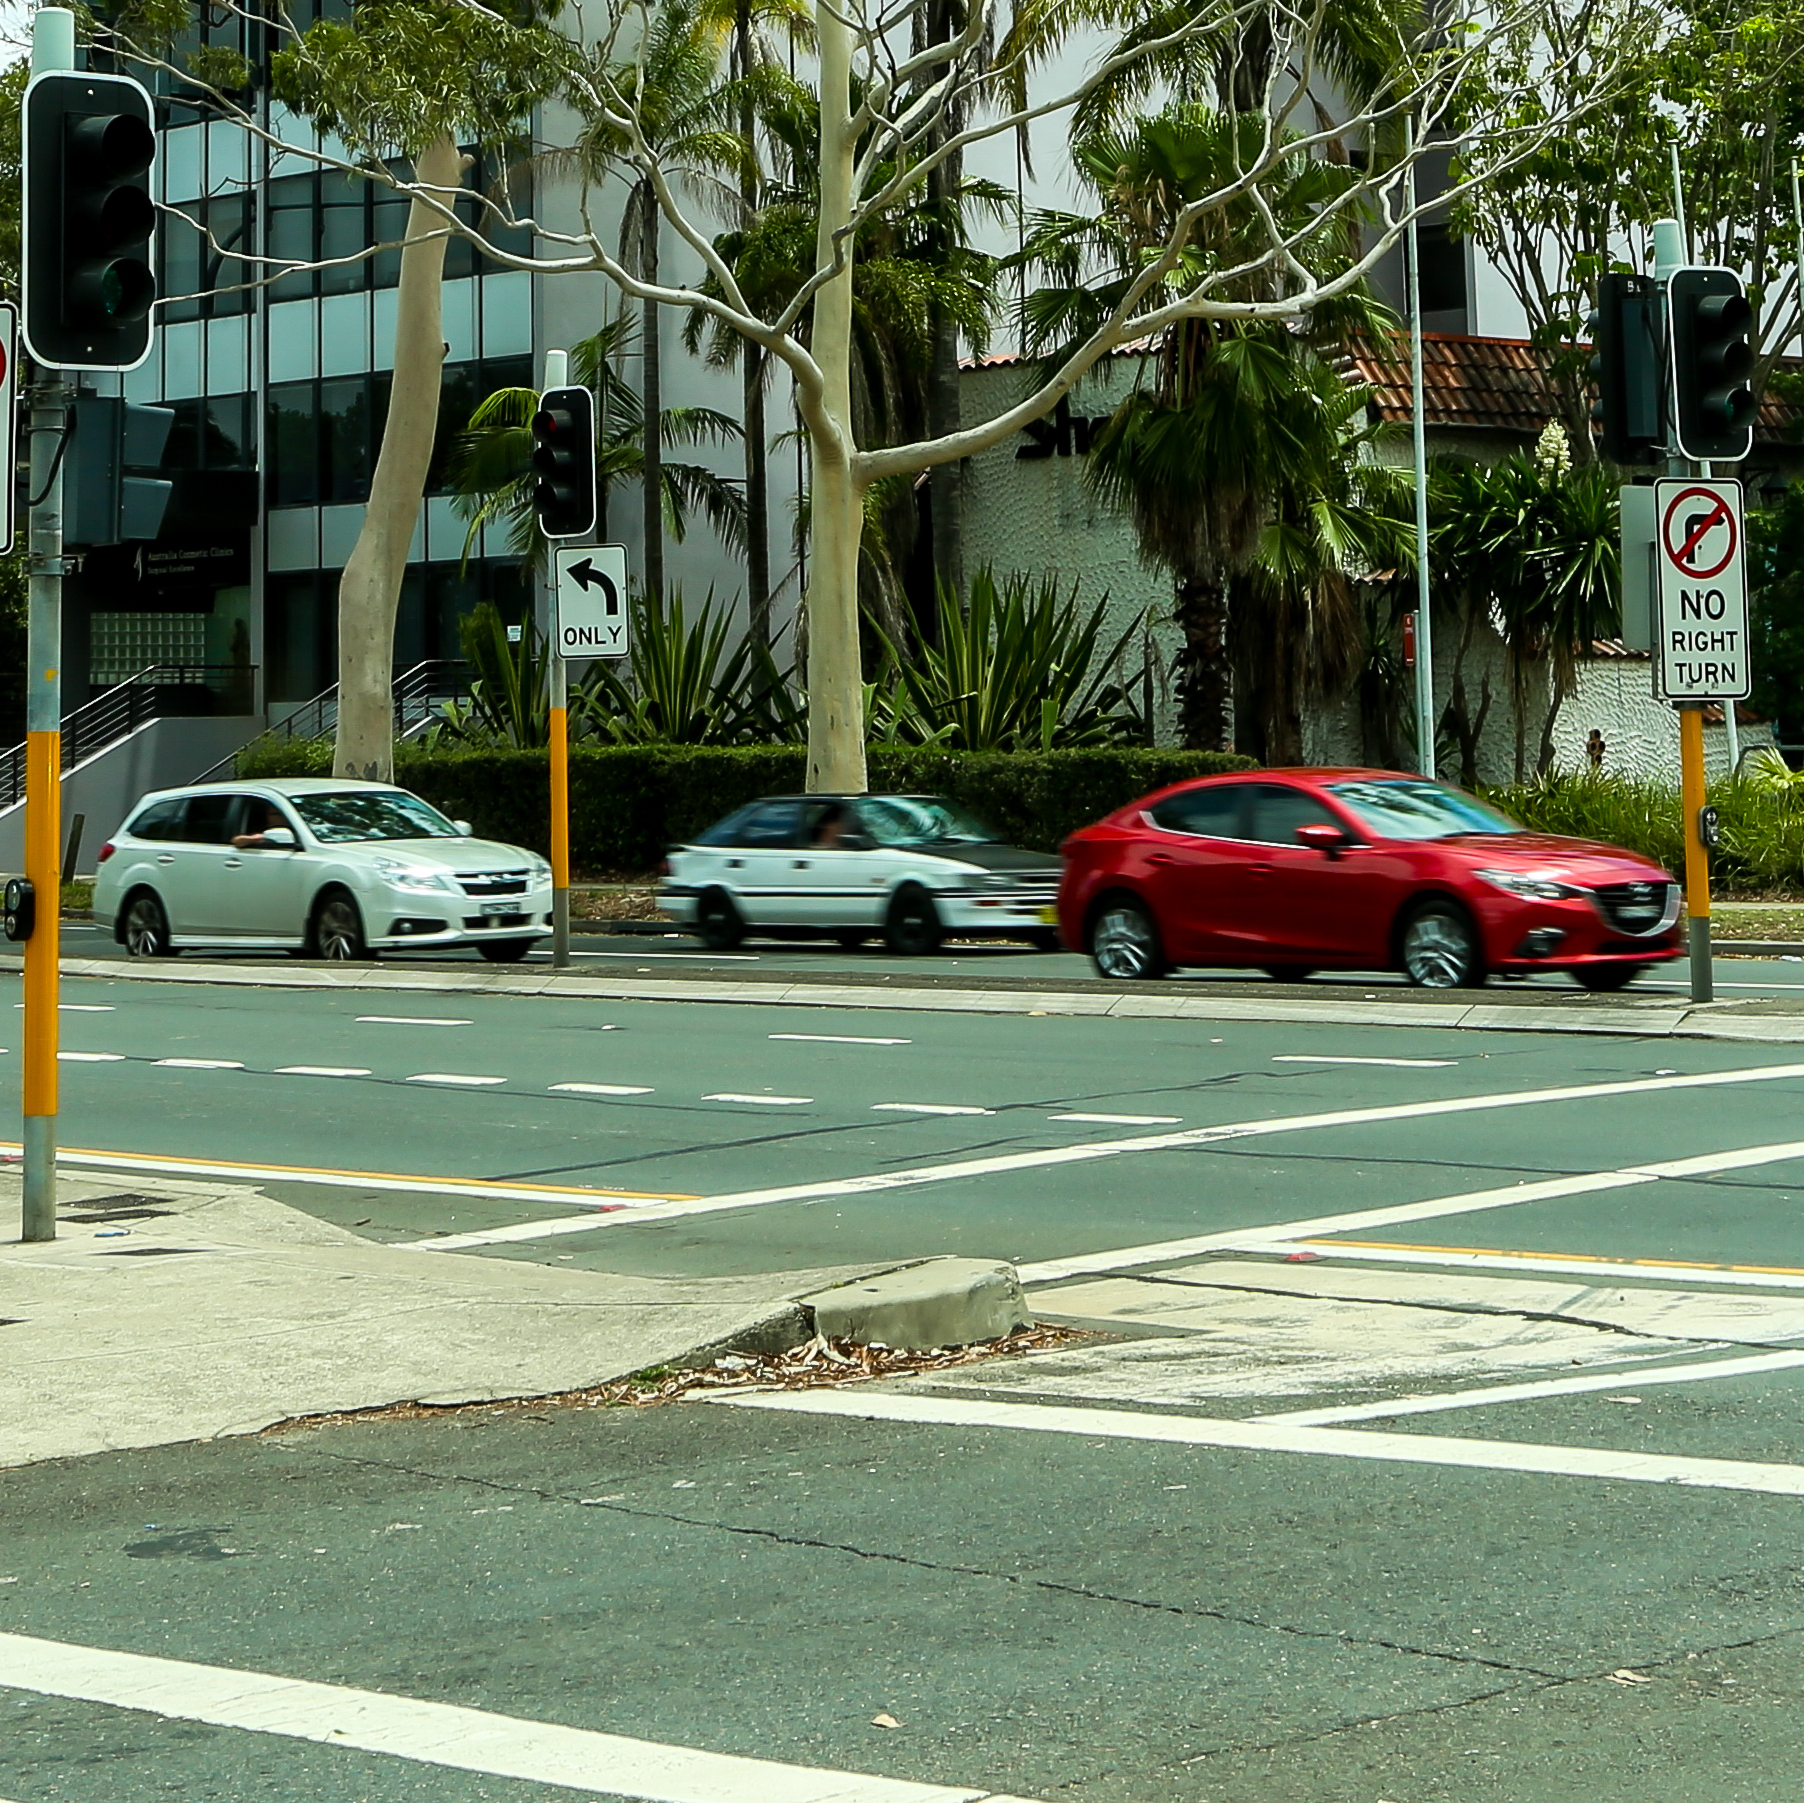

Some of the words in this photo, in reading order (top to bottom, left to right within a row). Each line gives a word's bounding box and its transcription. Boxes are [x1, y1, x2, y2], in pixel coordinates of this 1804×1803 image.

[1680, 589, 1725, 620] NO
[564, 625, 622, 645] ONLY
[1672, 630, 1738, 652] RIGHT
[1674, 662, 1736, 684] TURN
